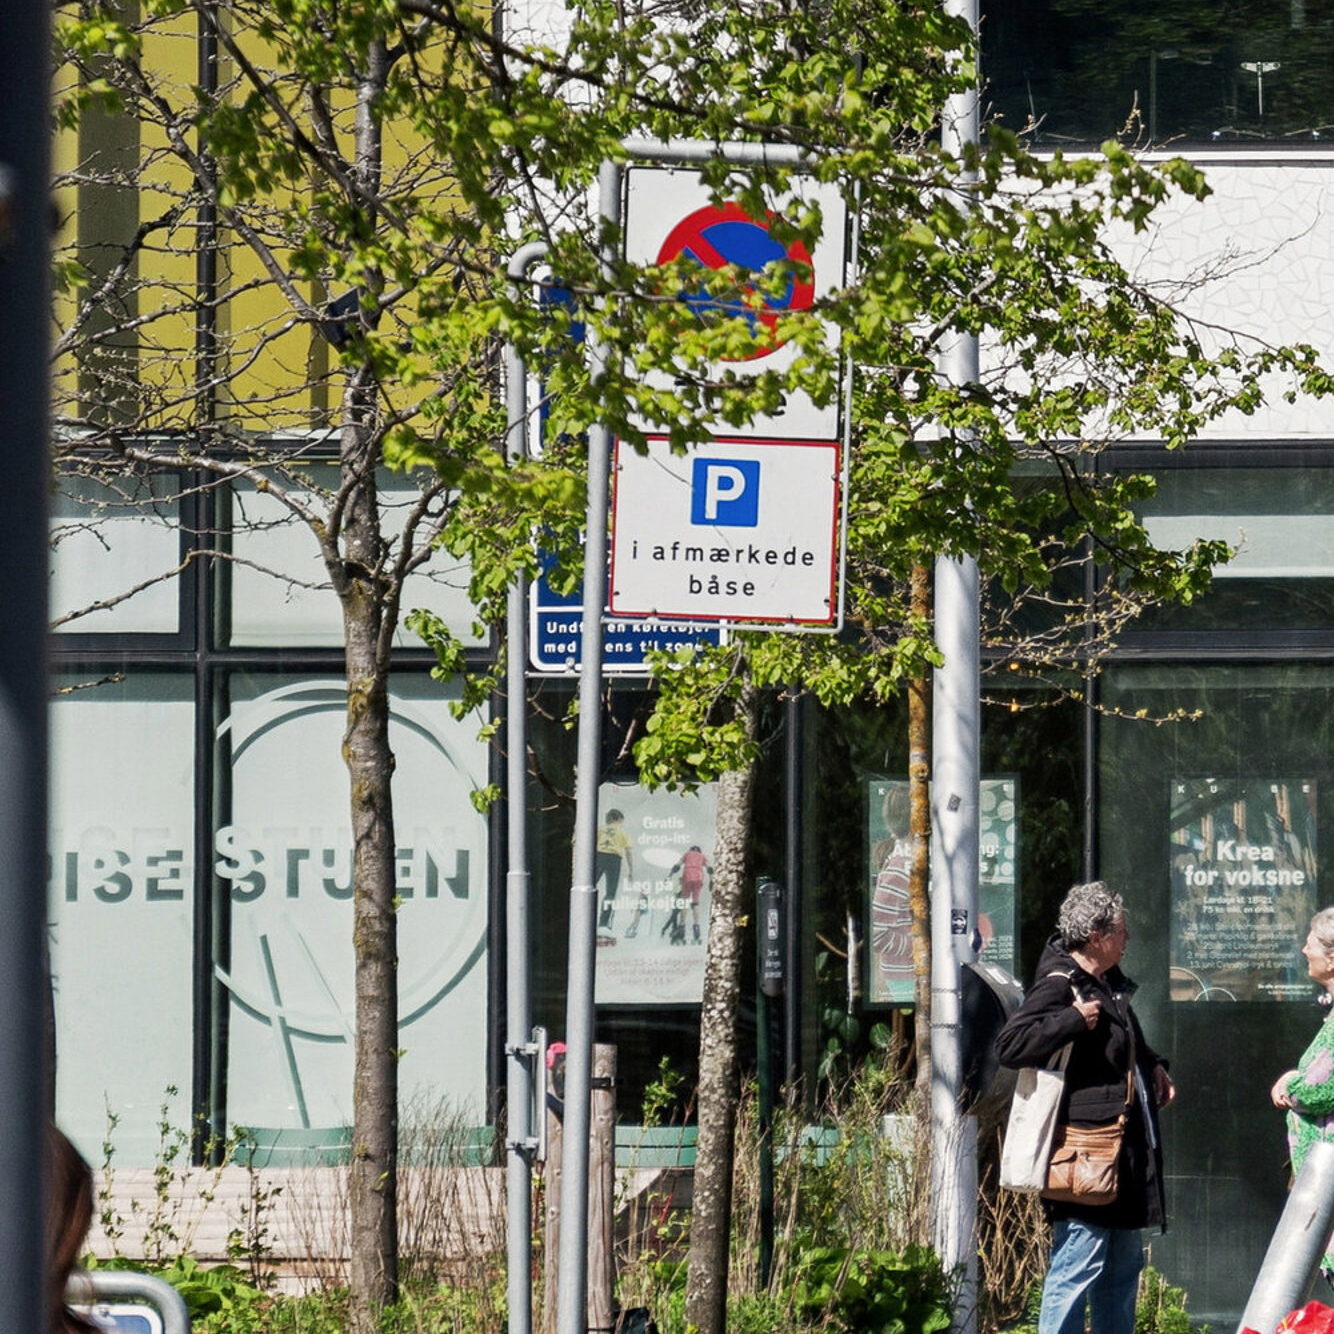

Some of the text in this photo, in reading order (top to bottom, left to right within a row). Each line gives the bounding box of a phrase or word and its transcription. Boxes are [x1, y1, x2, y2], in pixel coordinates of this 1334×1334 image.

[704, 465, 746, 520] P
[632, 540, 815, 566] i afmærkede
[689, 574, 756, 596] båse
[543, 640, 577, 654] med
[643, 817, 685, 830] Gratis
[638, 832, 690, 846] drop-in:
[1216, 840, 1275, 861] Krea
[1184, 864, 1305, 886] for voksne
[622, 878, 674, 894] Leg på
[603, 896, 693, 911] rulleskøjter
